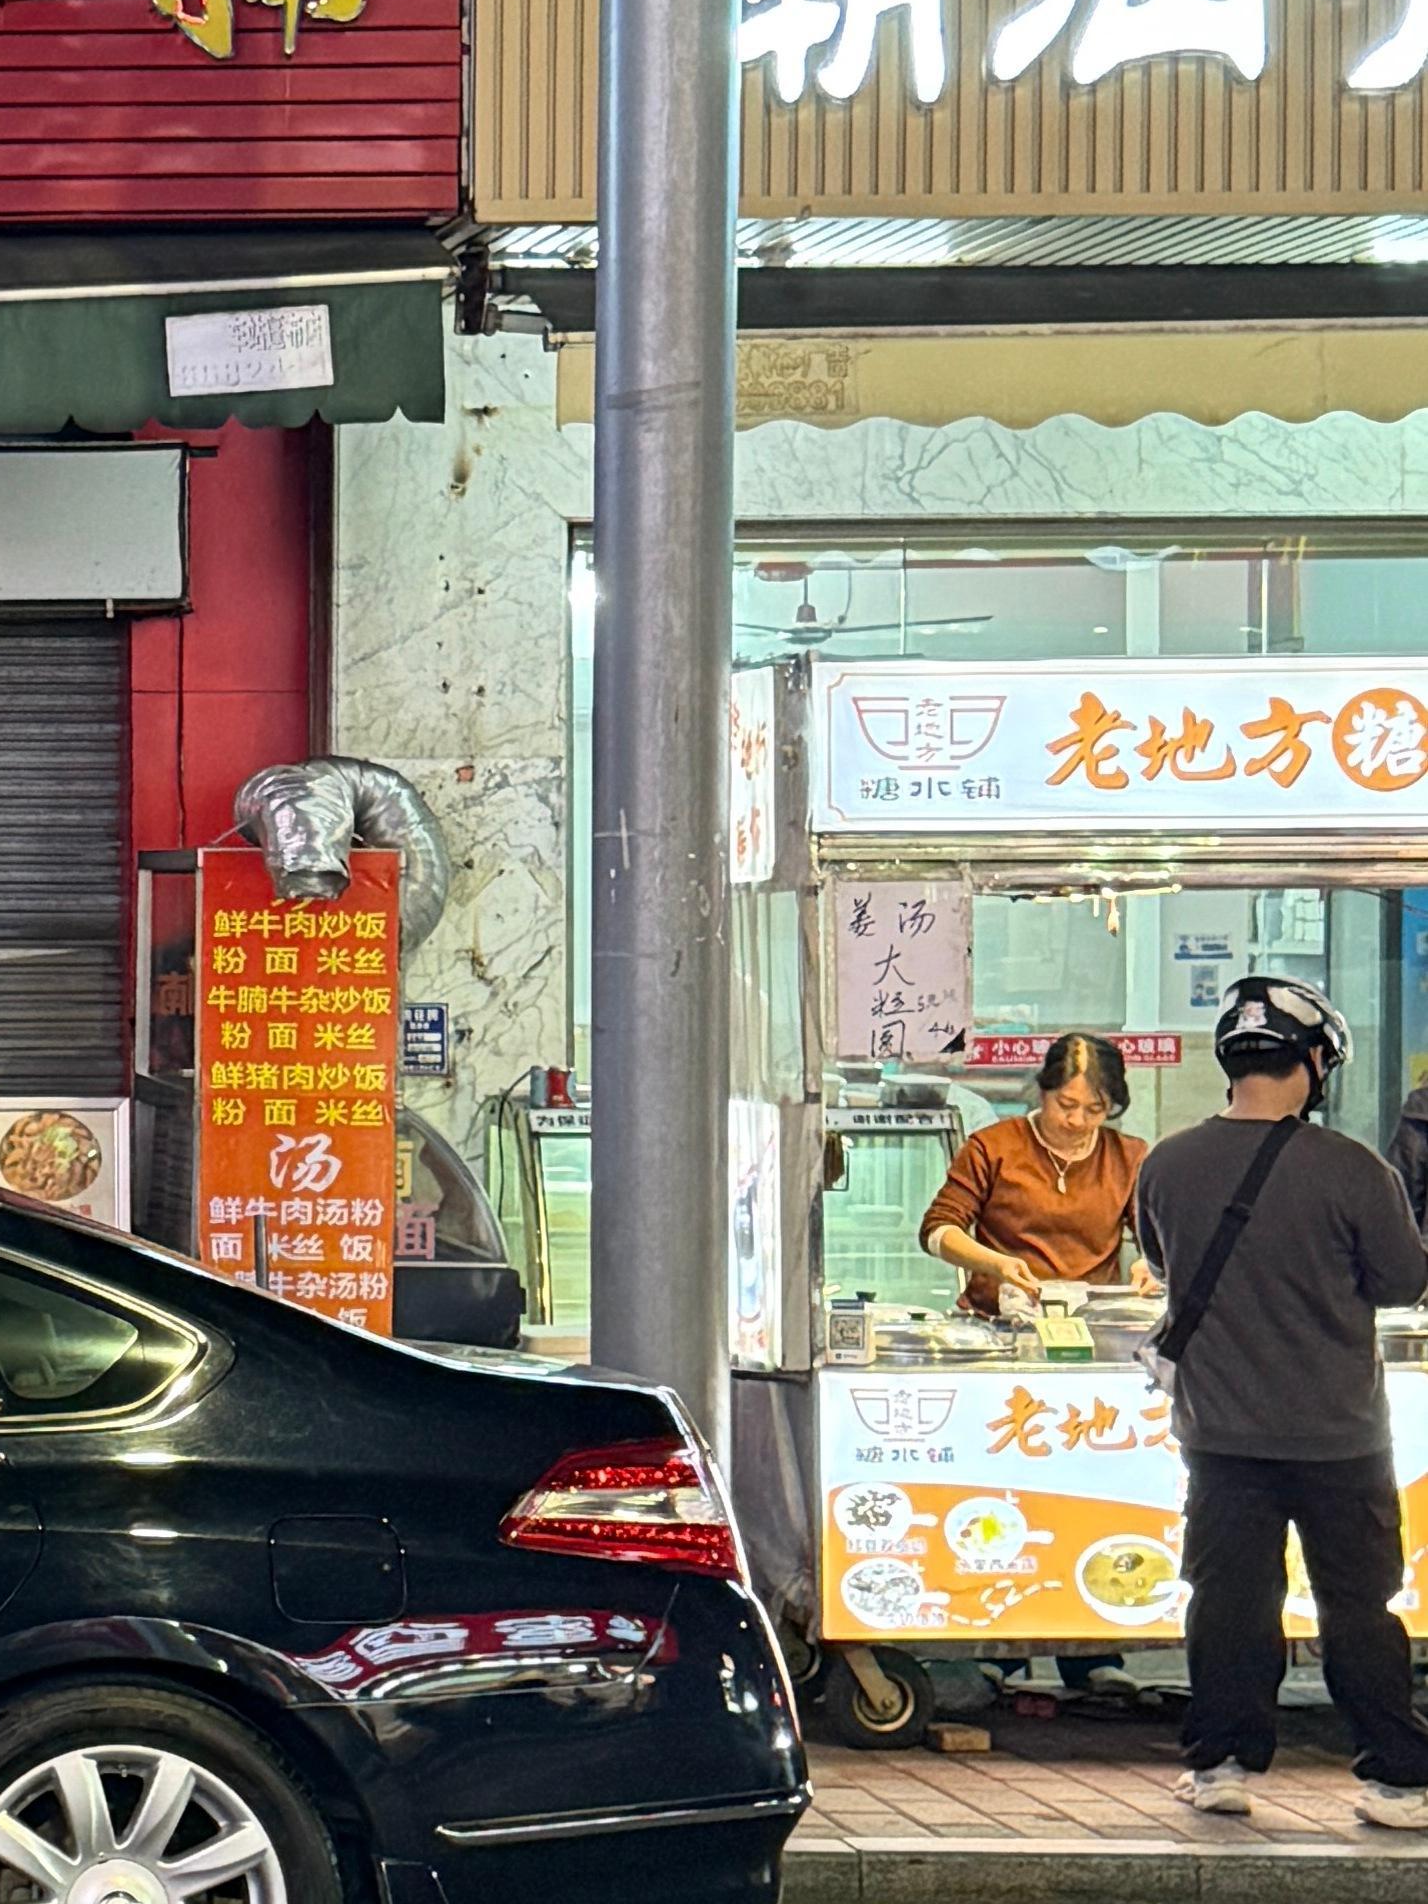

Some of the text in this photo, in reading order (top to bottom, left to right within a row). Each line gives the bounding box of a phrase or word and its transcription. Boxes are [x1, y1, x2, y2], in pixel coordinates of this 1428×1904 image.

[859, 776, 1001, 801] 糖水铺
[213, 909, 388, 939] 鲜牛肉炒饭
[212, 946, 246, 975] 粉
[265, 947, 298, 975] 面
[207, 985, 392, 1015] 牛腩牛杂炒饭
[220, 1021, 251, 1050] 粉
[267, 1022, 298, 1050] 面
[210, 1062, 386, 1093] 鲜猪肉炒饭
[212, 1097, 246, 1126] 粉
[264, 1098, 297, 1126] 面
[268, 1132, 343, 1192] 汤
[209, 1196, 384, 1227] 鲜牛肉汤粉
[210, 1232, 244, 1261] 面
[339, 1233, 375, 1262] 饭
